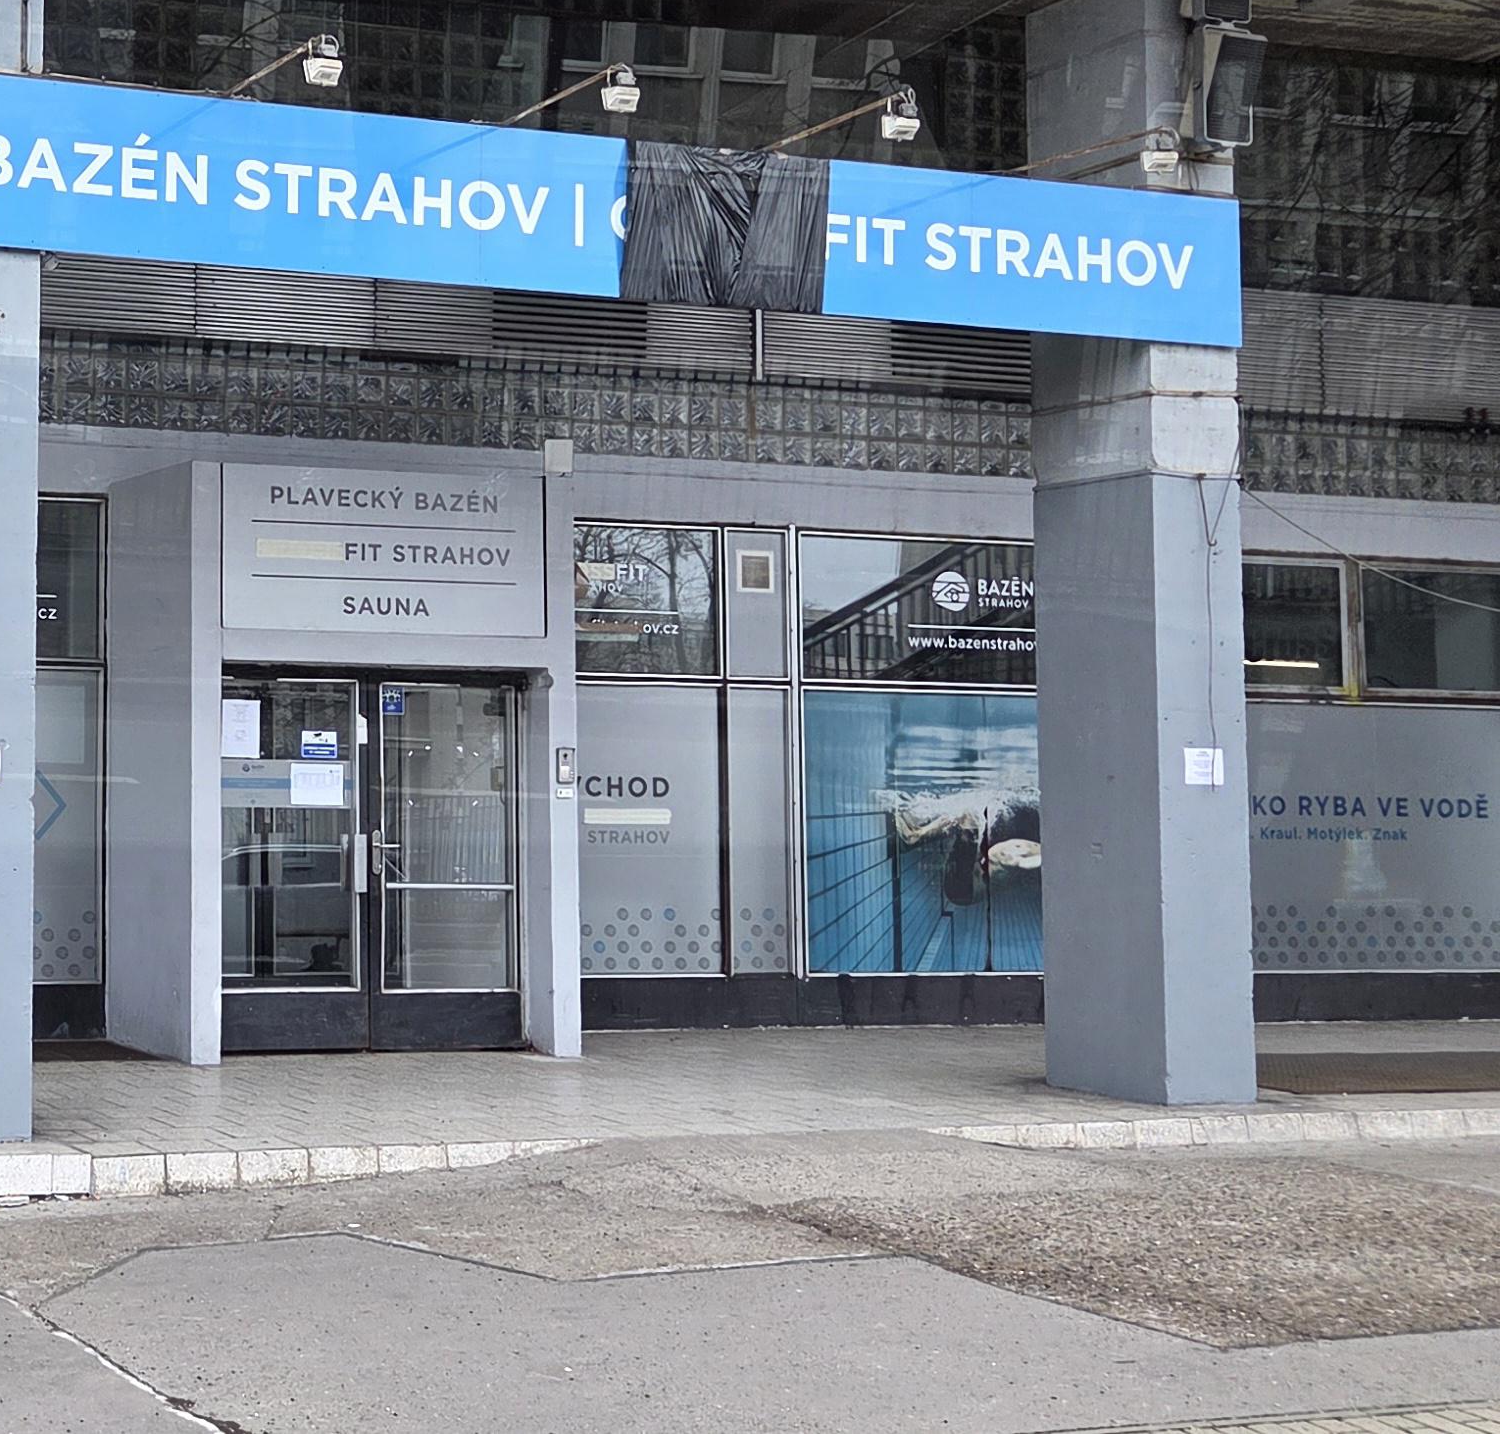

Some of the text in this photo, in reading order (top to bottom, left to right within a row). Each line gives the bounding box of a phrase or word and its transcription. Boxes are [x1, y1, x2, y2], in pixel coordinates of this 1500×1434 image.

[233, 160, 550, 235] STRAHOV
[924, 220, 1194, 290] STRAHOV
[270, 485, 499, 514] PLAVECKÝ BAZÉN
[344, 542, 511, 567] FIT STRAHOV
[342, 595, 430, 617] SAUNA
[978, 597, 1030, 609] STRAHOV
[907, 635, 1037, 652] www.bazenstraho
[1299, 795, 1367, 817] RYBA
[1376, 797, 1409, 817] VE
[1419, 793, 1489, 819] VODĚ
[587, 830, 671, 845] STRAHOV
[1373, 828, 1407, 841] Znak
